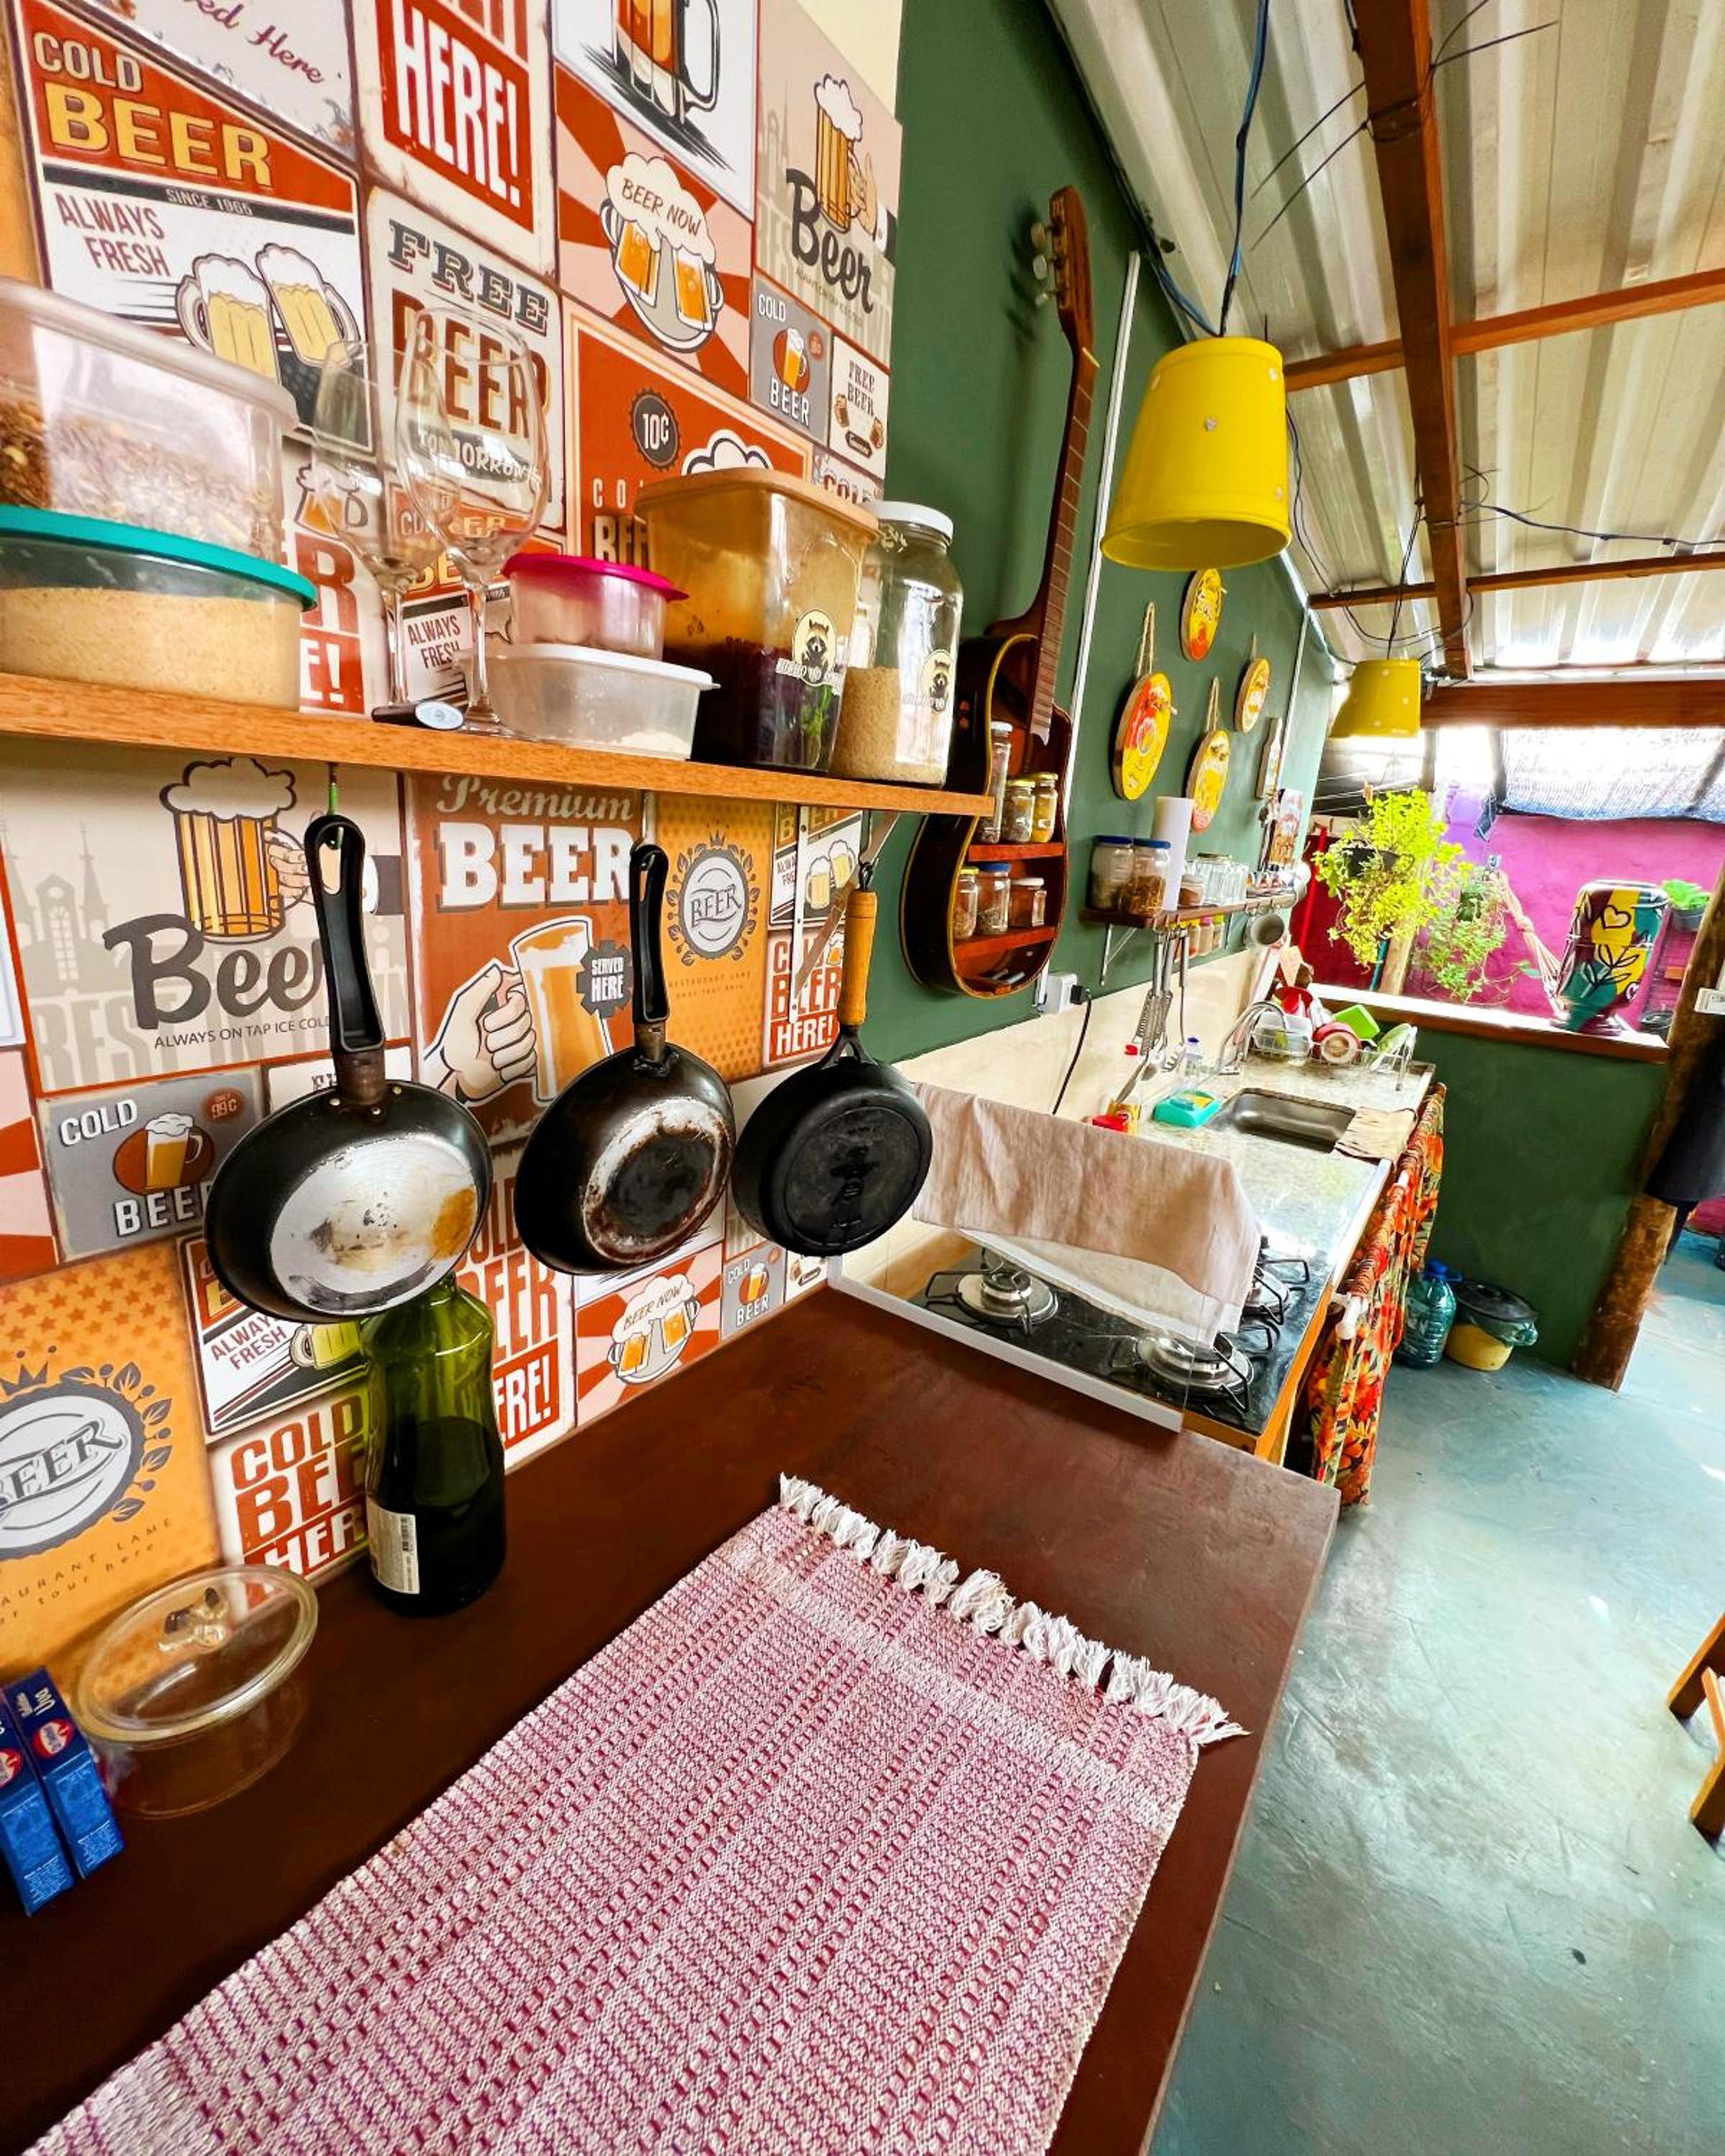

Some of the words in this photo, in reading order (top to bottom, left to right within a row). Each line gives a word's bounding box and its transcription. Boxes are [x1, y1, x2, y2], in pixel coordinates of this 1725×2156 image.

[34, 32, 142, 93] COLD
[247, 25, 325, 83] Here
[392, 0, 520, 208] HERE!
[45, 80, 272, 187] BEER
[55, 193, 165, 240] ALWAYS
[165, 188, 212, 208] SINCE
[622, 177, 663, 216] BEER
[666, 204, 702, 237] NOW
[84, 236, 171, 277] FRESH
[786, 168, 874, 314] Beer
[387, 218, 549, 336] FREE
[758, 295, 787, 323] COLD
[392, 287, 549, 439] BEER
[770, 376, 810, 426] BEER
[847, 382, 875, 416] BEER
[643, 413, 669, 451] 10¢
[408, 614, 461, 645] ALWAYS
[436, 775, 633, 821] Premium
[438, 821, 632, 907] BEER
[690, 884, 742, 929] BEER
[591, 975, 624, 1003] HERE
[771, 965, 842, 1020] BER
[155, 1031, 216, 1049] ALWAYS
[219, 1027, 242, 1041] ON
[244, 1024, 271, 1038] TAP
[275, 1021, 296, 1033] ICE
[776, 1014, 834, 1056] HERE!
[60, 1098, 138, 1146] COLD
[456, 1176, 522, 1271] OLD
[736, 1294, 769, 1327] BEER
[211, 1315, 279, 1360] ALWAY
[229, 1326, 288, 1370] FRESH
[493, 1354, 552, 1447] ERE!
[0, 1421, 123, 1506] EER
[231, 1395, 364, 1491] COLD
[235, 1439, 365, 1555] BEE
